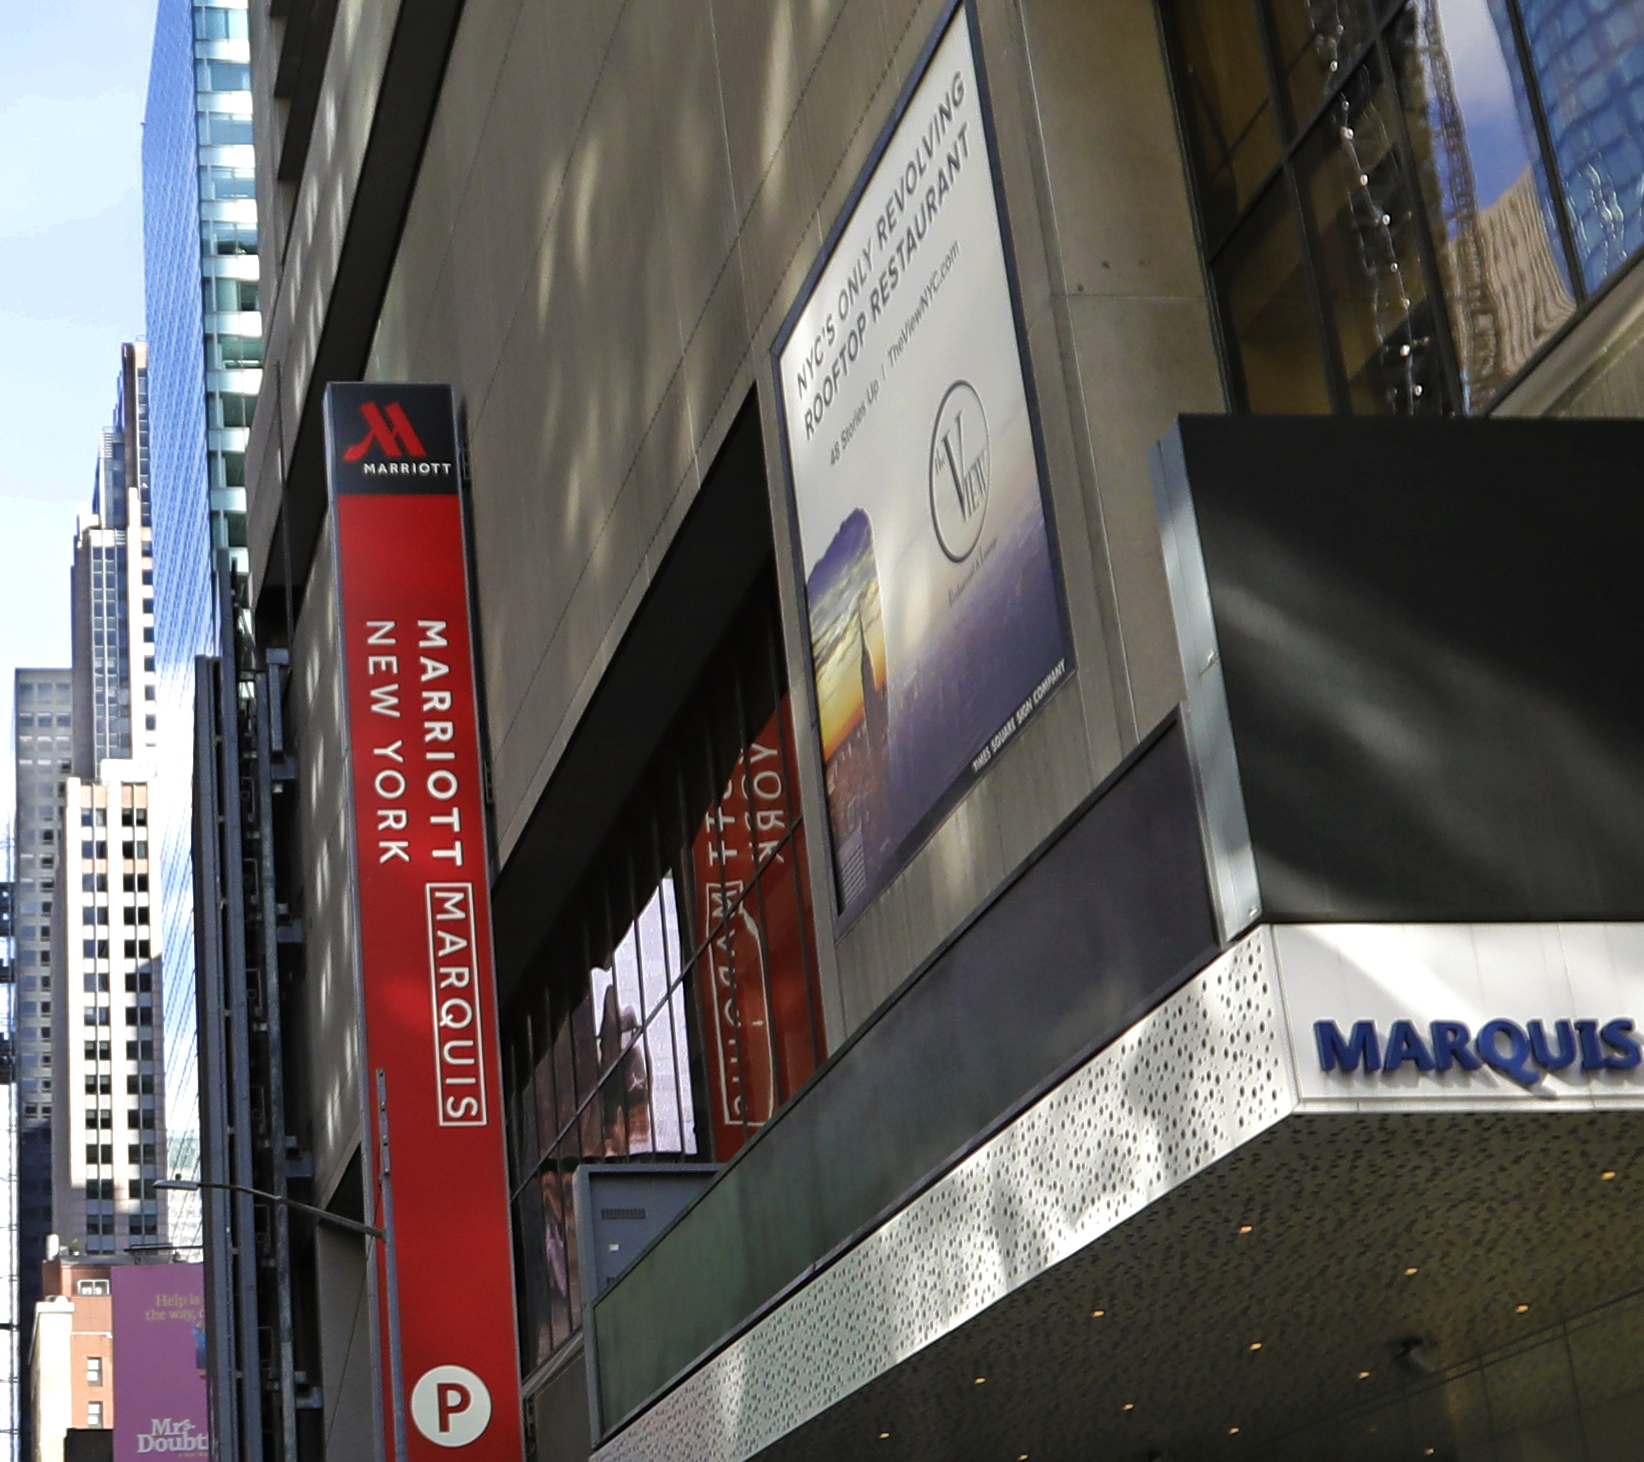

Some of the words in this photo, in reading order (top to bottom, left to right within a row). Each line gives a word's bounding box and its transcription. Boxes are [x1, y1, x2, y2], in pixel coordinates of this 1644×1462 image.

[797, 314, 837, 400] NYC'S
[838, 248, 874, 321] ONLY
[877, 70, 967, 246] REVOLVING
[803, 316, 867, 441] ROOFTOP
[871, 122, 972, 325] RESTAURANT
[841, 402, 867, 449] Stories
[868, 378, 880, 407] Up
[363, 462, 452, 475] MARRIOTT
[366, 620, 401, 720] NEW
[972, 748, 991, 774] TIMES
[991, 717, 1016, 754] SQUARE
[1016, 700, 1033, 726] SIGN
[1033, 658, 1067, 706] COMPANY
[416, 619, 467, 868] MARRIOTT
[371, 740, 410, 866] YORK
[433, 890, 480, 1121] MARQUIS
[1313, 1018, 1644, 1086] MARQUIS
[156, 1294, 186, 1308] Help
[438, 1381, 470, 1434] P
